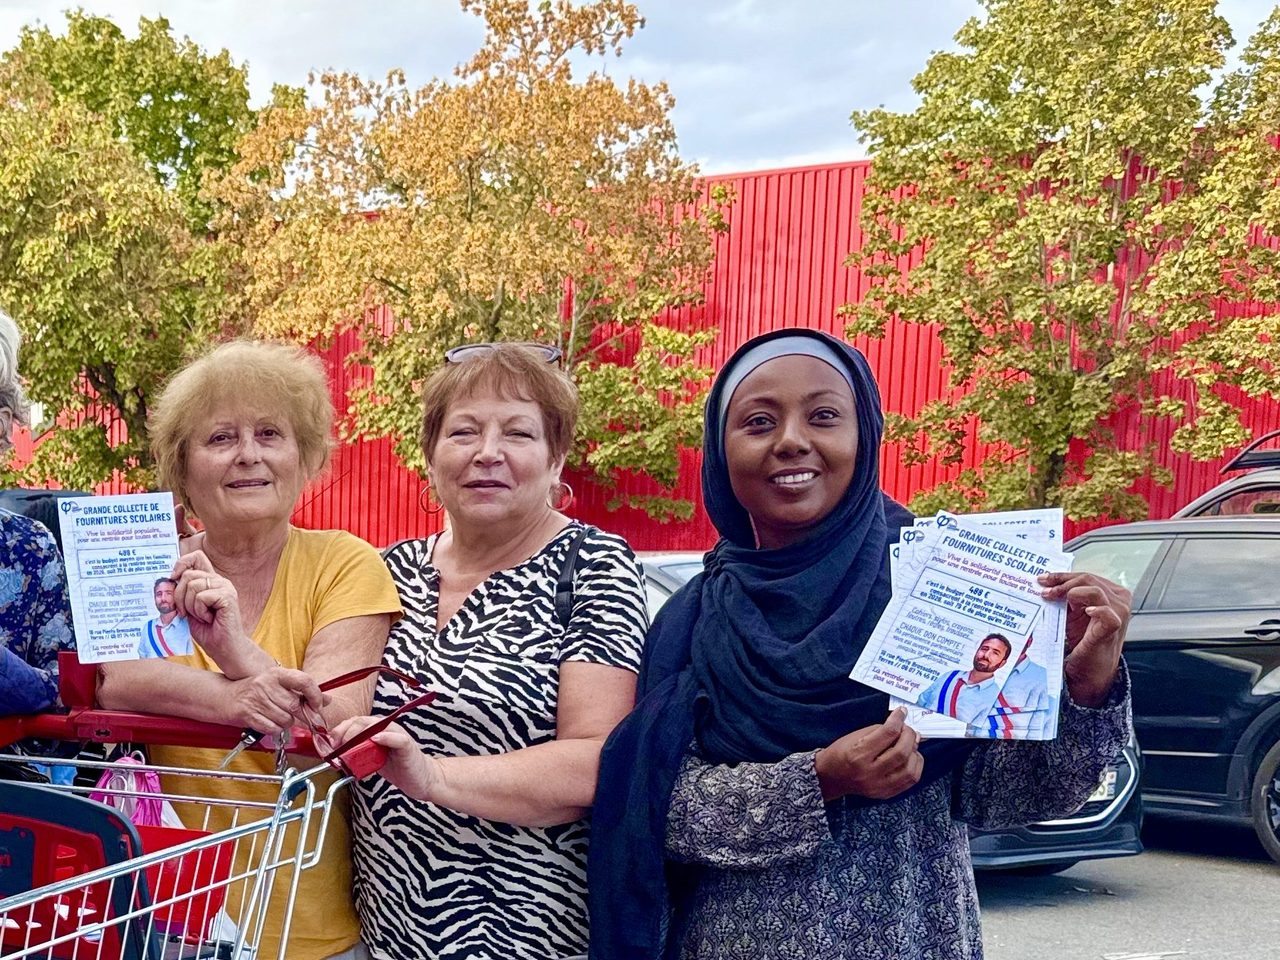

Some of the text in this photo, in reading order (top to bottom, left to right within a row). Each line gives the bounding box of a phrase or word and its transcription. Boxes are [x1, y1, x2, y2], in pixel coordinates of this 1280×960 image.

[75, 512, 171, 526] FOURNITURES SCOLAIRES
[83, 505, 111, 515] GRANDE
[112, 503, 148, 513] COLLECTE
[149, 502, 159, 511] DE
[941, 535, 1005, 564] FOURNITURES
[957, 528, 1049, 566] GRANDE COLLECTE DE
